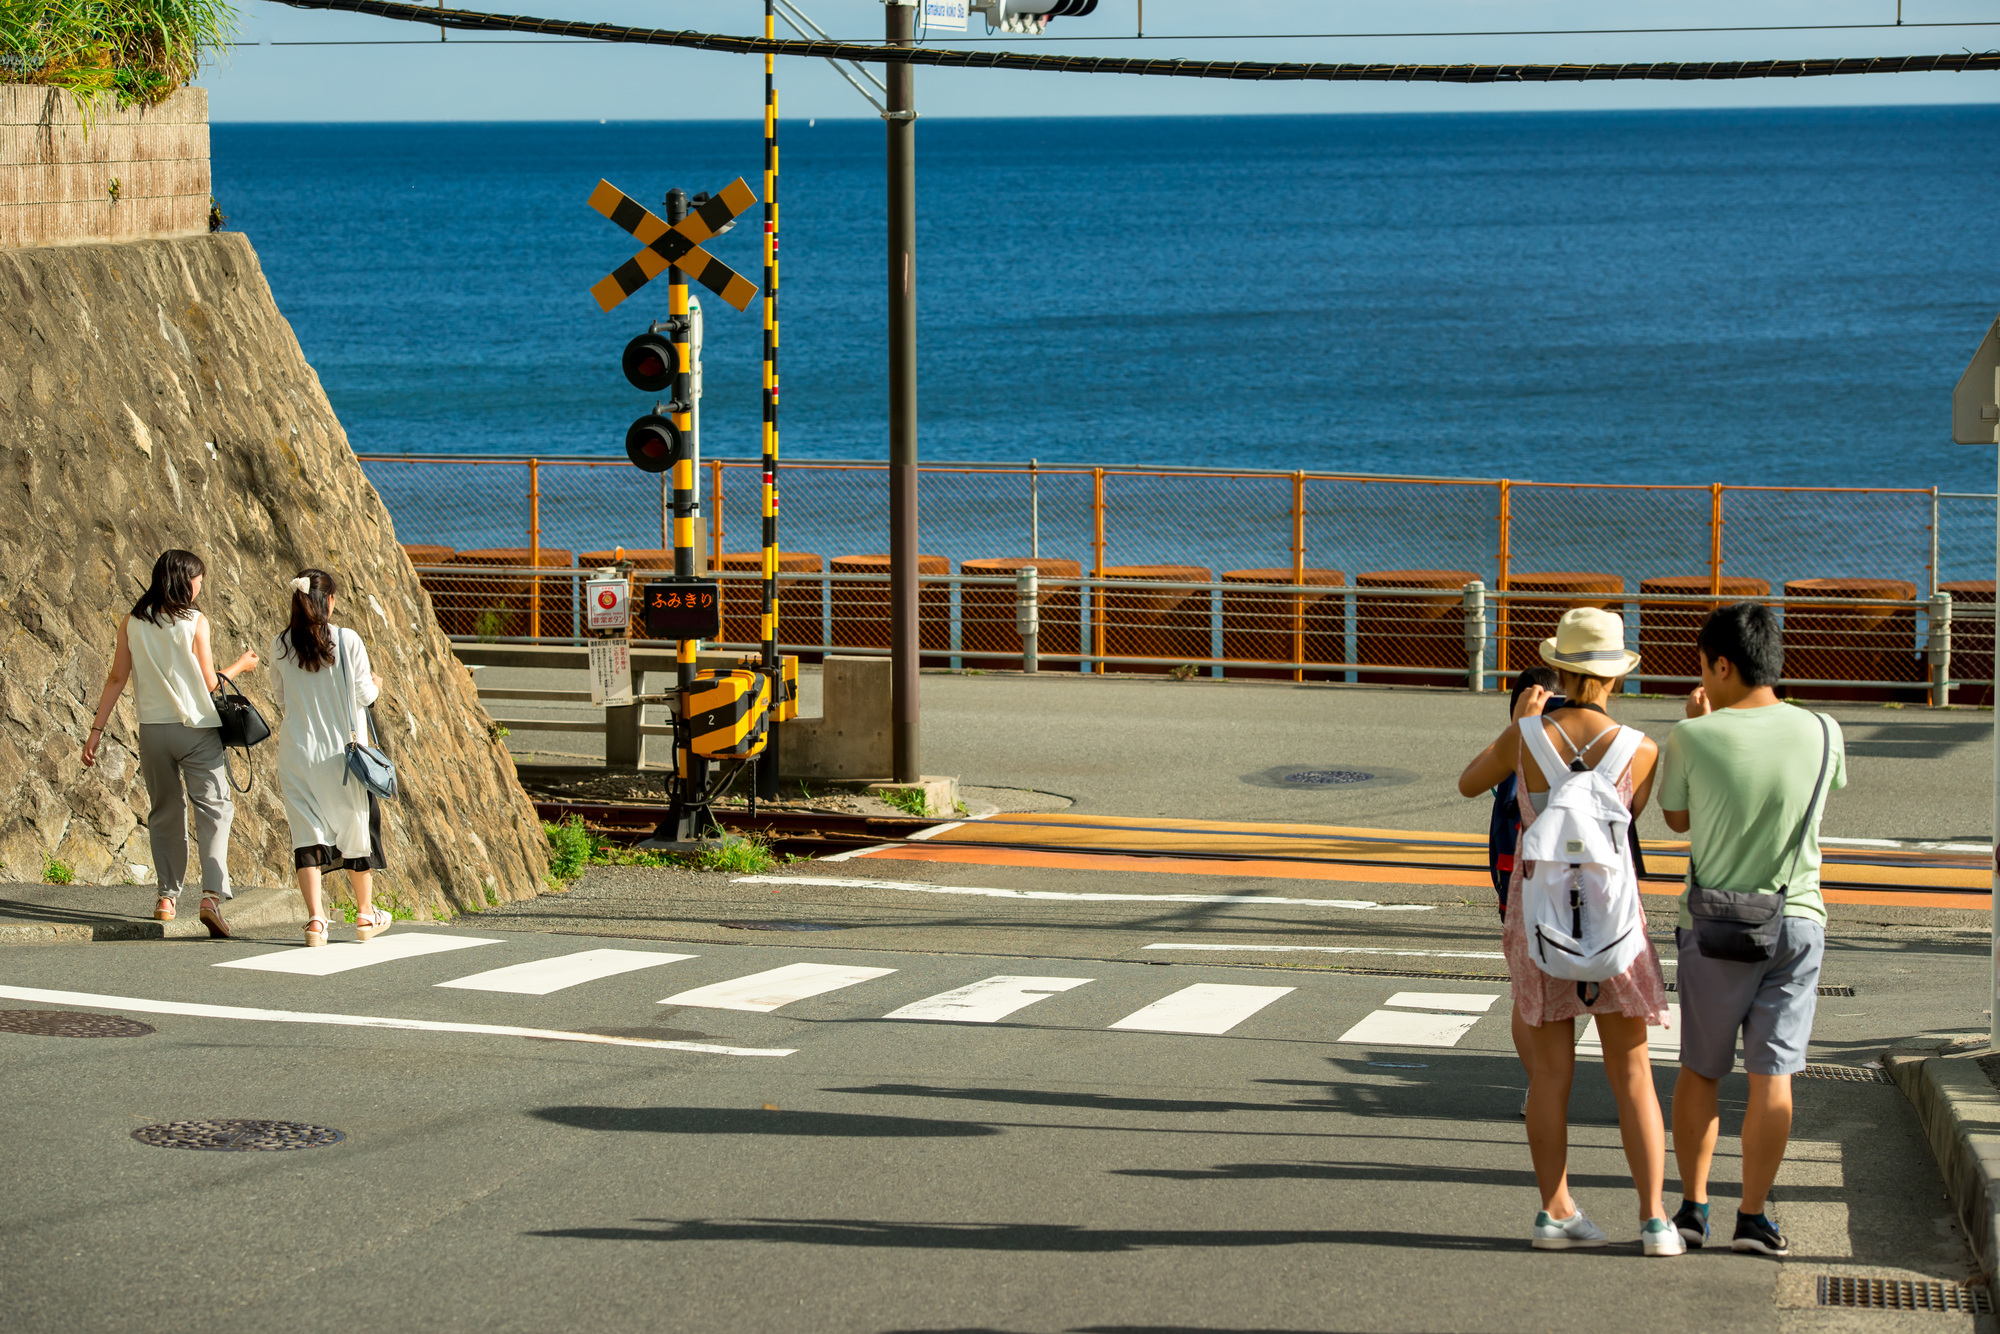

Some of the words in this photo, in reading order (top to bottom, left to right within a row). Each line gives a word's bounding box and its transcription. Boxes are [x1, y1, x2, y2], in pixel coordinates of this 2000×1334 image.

[651, 592, 712, 608] ふみきり
[593, 615, 624, 624] 非常ボタン
[708, 714, 715, 725] 2
